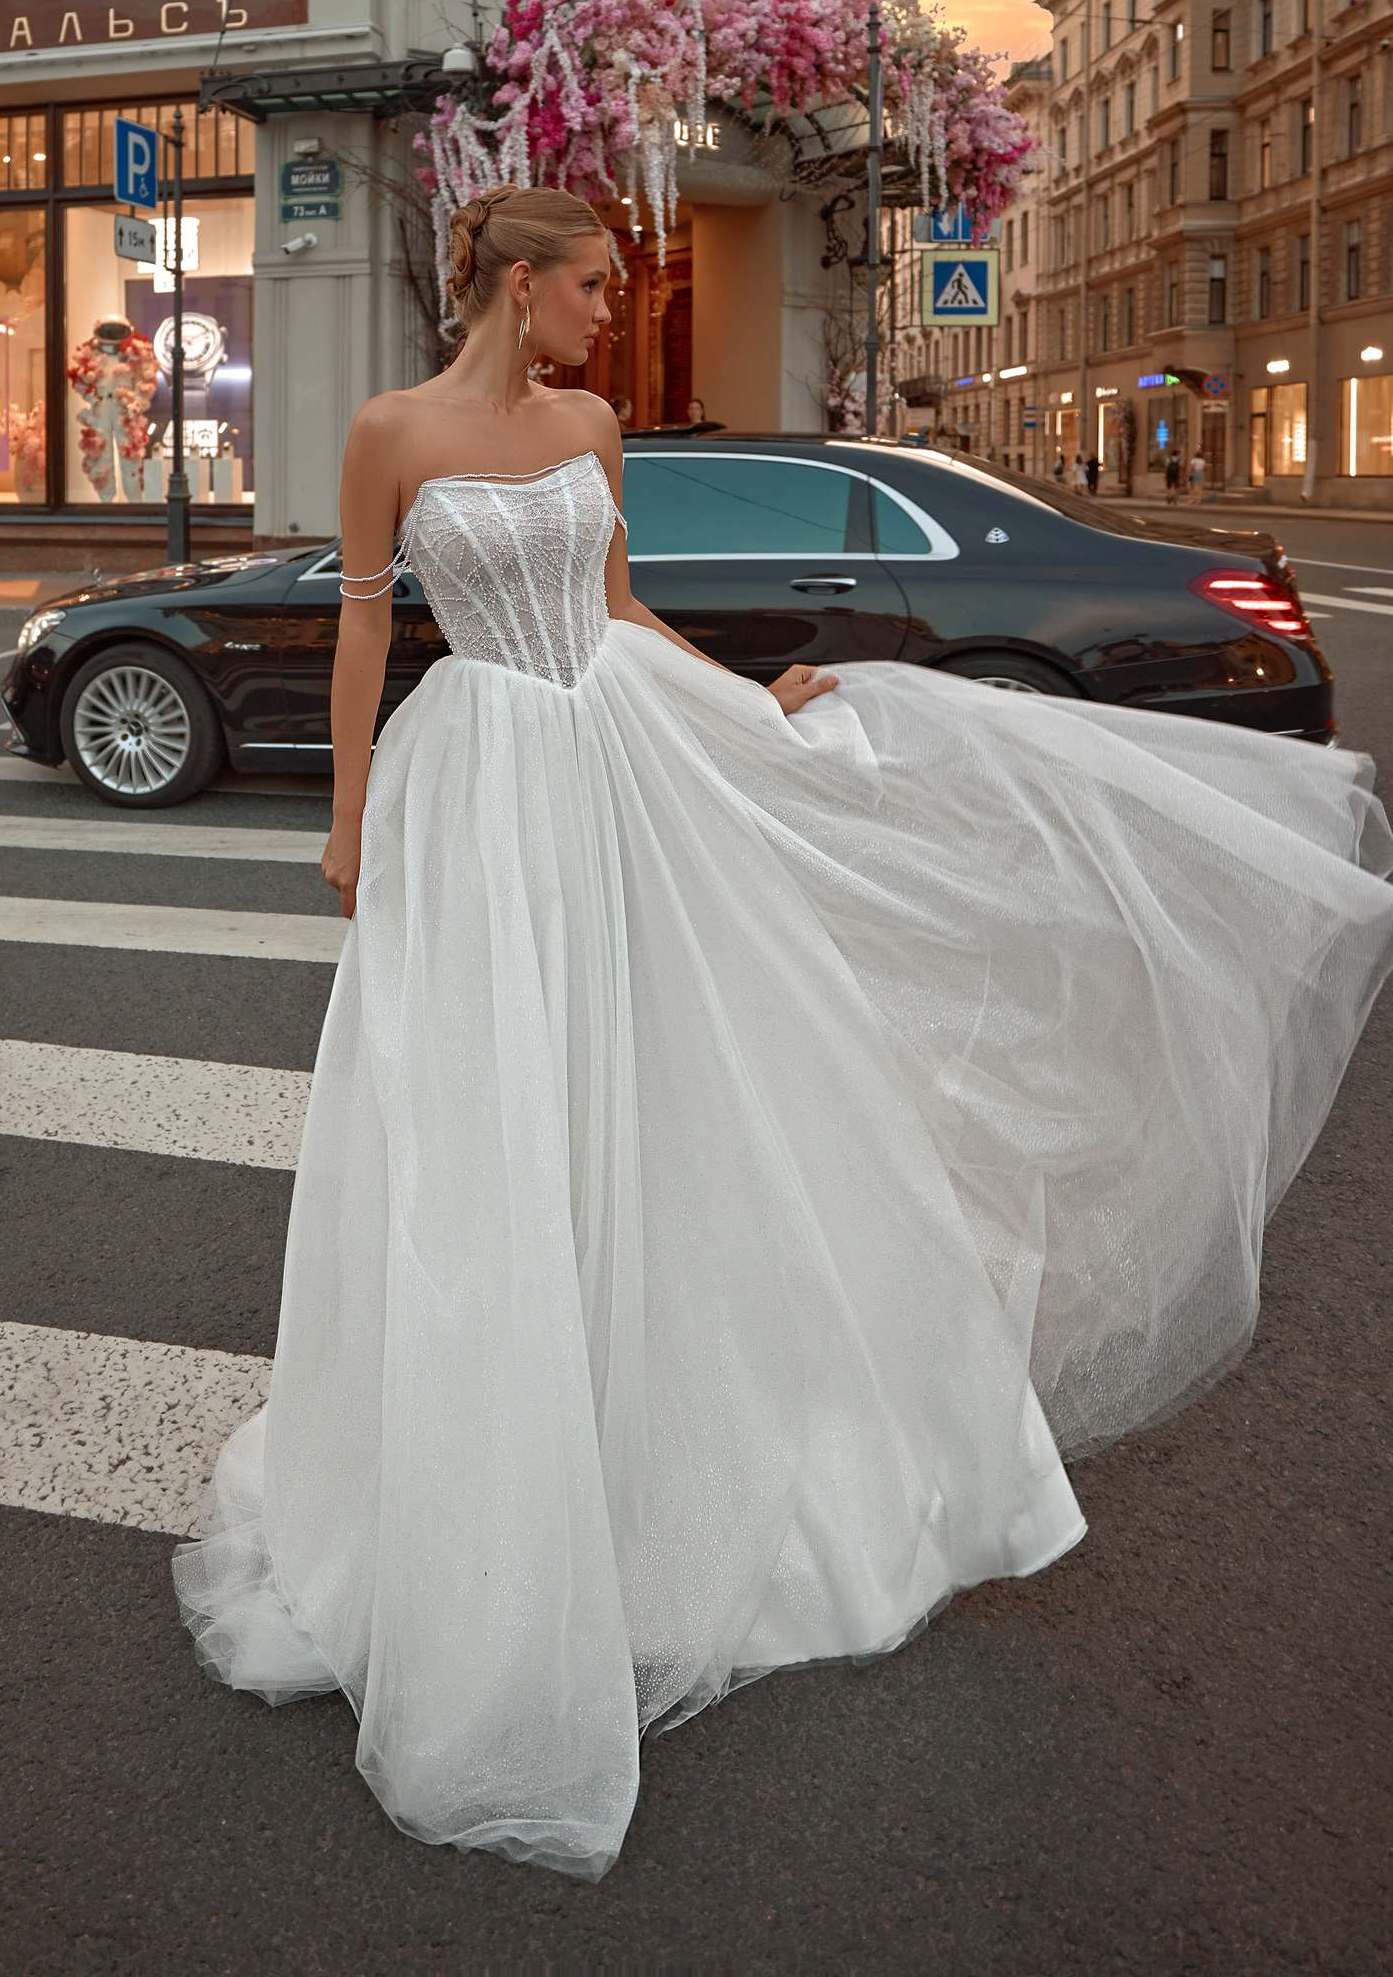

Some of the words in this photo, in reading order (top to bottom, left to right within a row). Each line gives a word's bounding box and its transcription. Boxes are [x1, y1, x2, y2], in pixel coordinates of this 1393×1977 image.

[10, 0, 248, 48] АЛЬСЪ
[127, 131, 152, 194] P
[291, 172, 330, 185] МОЙКИ
